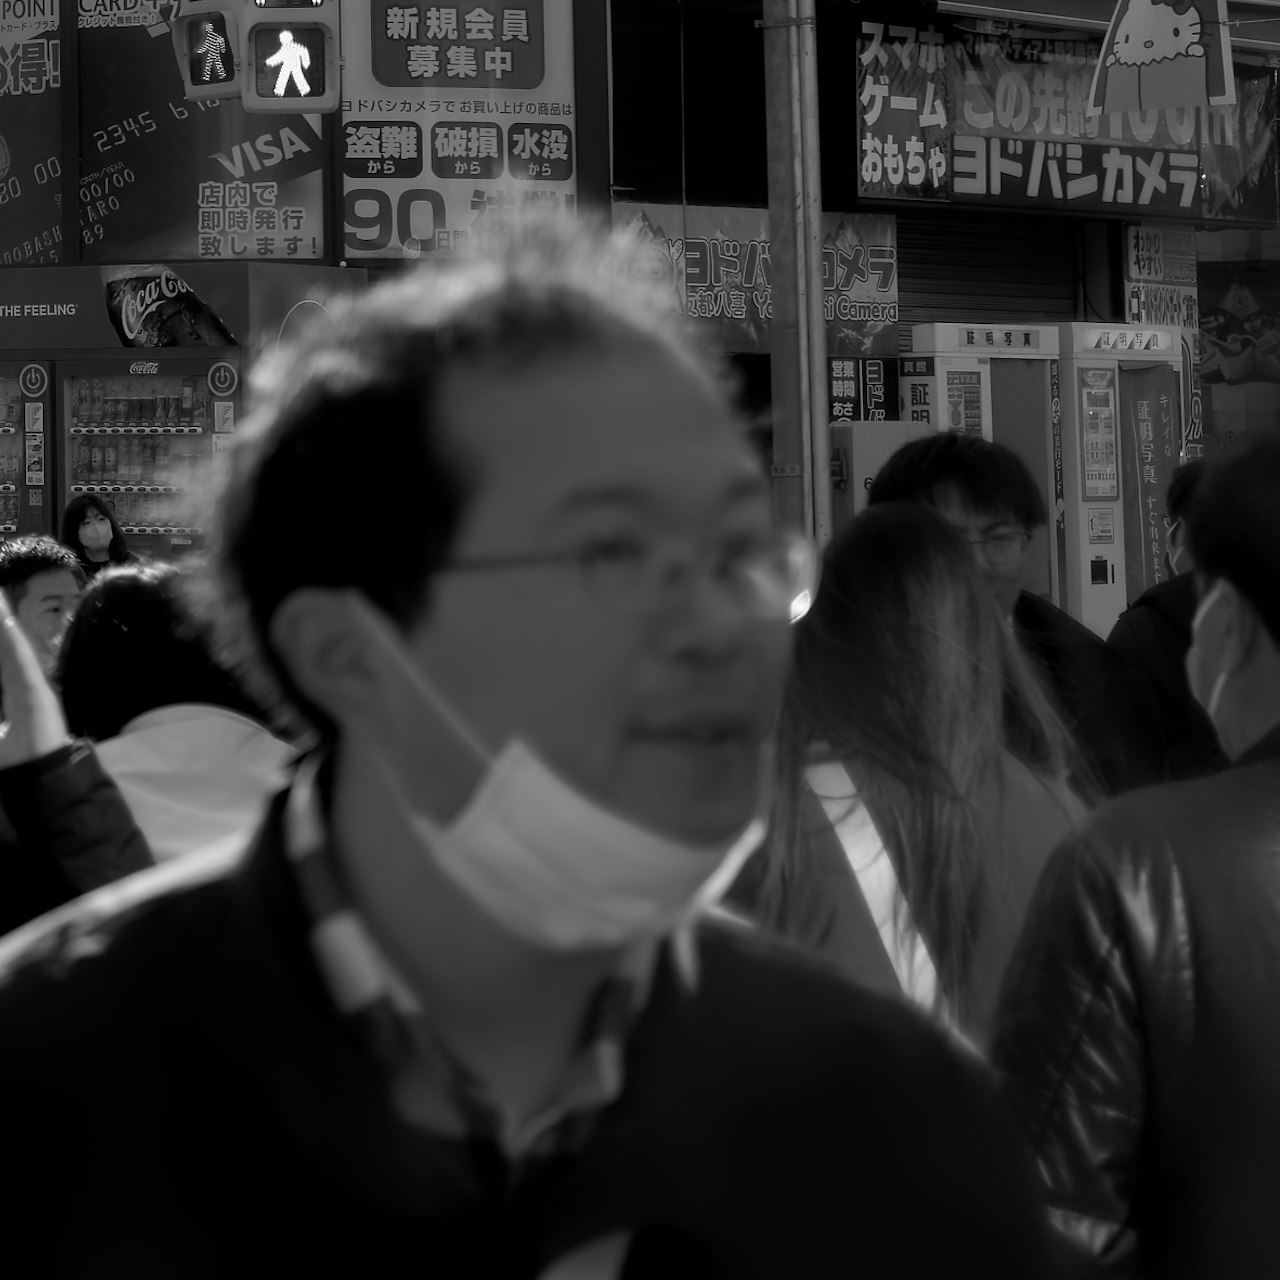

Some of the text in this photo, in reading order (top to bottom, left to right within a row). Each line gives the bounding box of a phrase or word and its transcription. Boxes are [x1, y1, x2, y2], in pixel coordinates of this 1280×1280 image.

[385, 6, 530, 43] 新規会員
[406, 44, 513, 80] 募集中
[859, 21, 945, 74] スマホ
[860, 74, 948, 129] ゲーム
[91, 111, 159, 154] 2345
[344, 126, 569, 161] 盗難 破損 水没
[207, 125, 313, 180] VISA
[367, 160, 552, 176] から から から
[860, 132, 947, 188] おもちゃ
[952, 133, 1200, 209] ヨドバシカメラ
[80, 196, 120, 225] ARO
[198, 180, 278, 207] 店内で
[198, 207, 306, 232] 即時発行
[344, 188, 447, 251] 90
[200, 233, 318, 258] 致します!
[23, 303, 77, 317] FEELING
[836, 297, 899, 322] Camera
